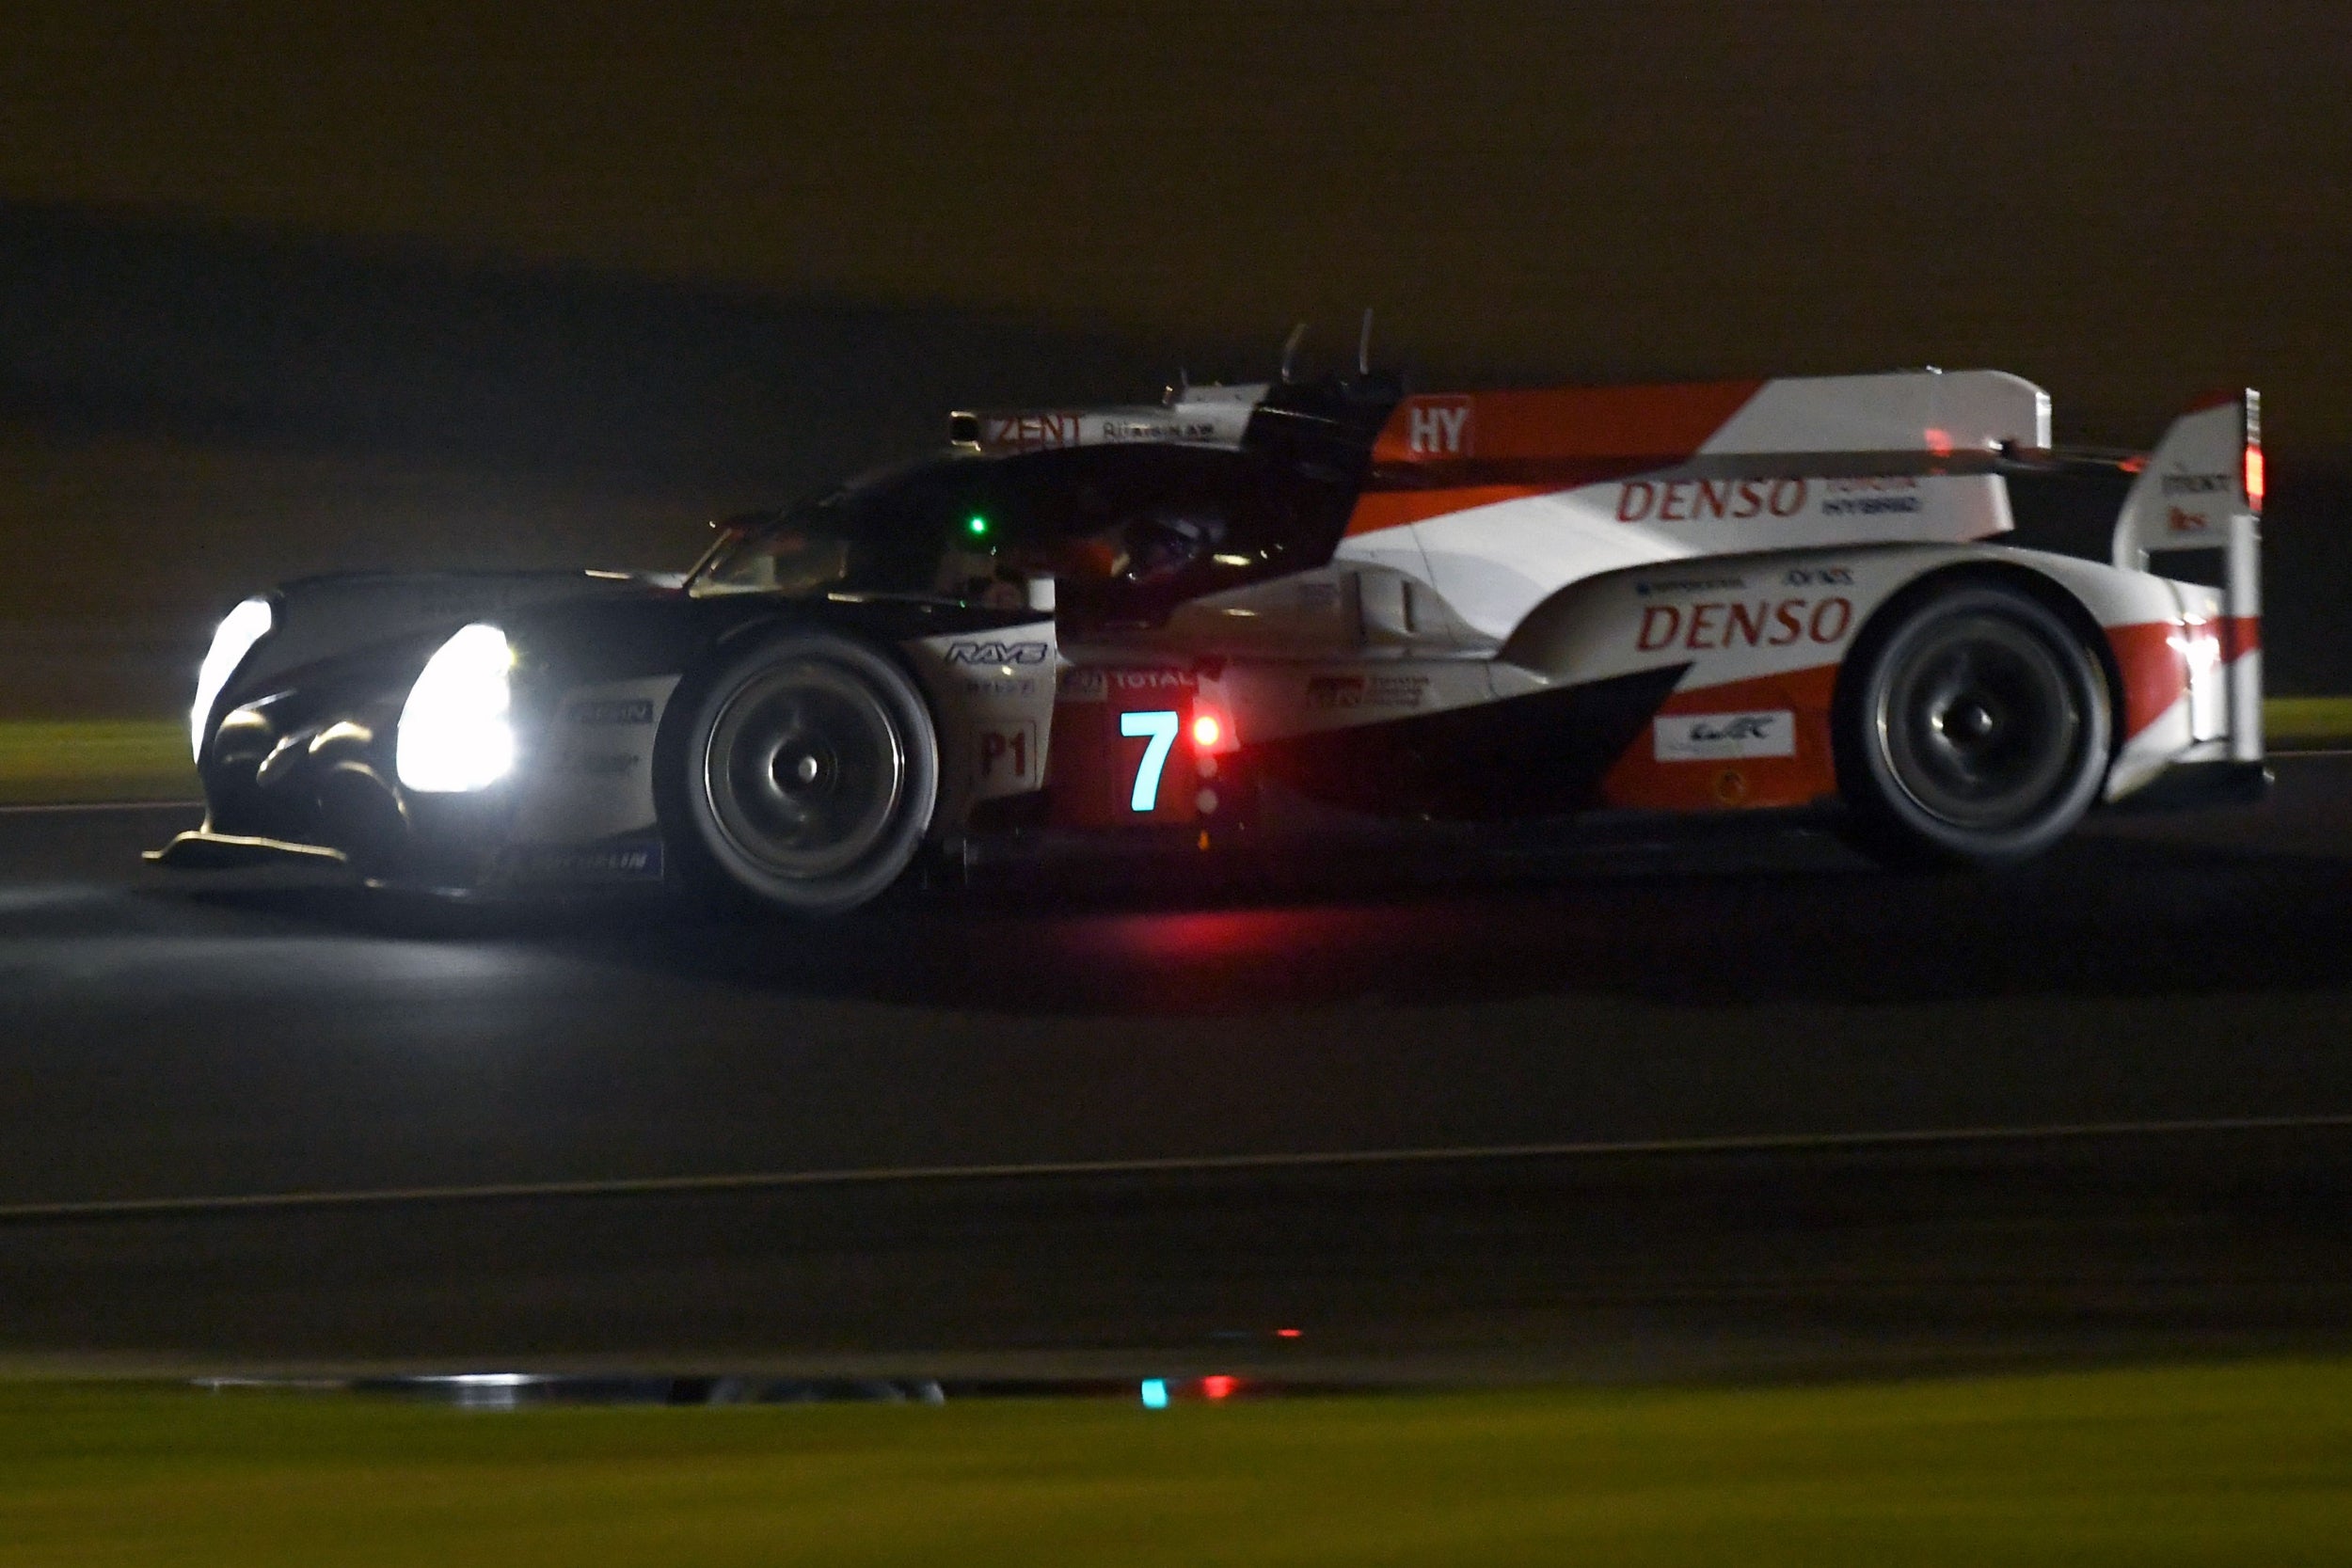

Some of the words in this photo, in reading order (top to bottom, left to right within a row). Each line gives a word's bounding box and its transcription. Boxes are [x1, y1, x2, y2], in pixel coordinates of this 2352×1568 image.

[993, 410, 1082, 451] ZENT
[1410, 406, 1470, 453] HY
[1614, 476, 1810, 523] DENSO
[1635, 596, 1853, 653] DENSO
[945, 641, 1050, 666] RAYS
[1114, 669, 1196, 691] TOTAL
[980, 729, 1027, 779] P1
[1119, 710, 1180, 813] 7
